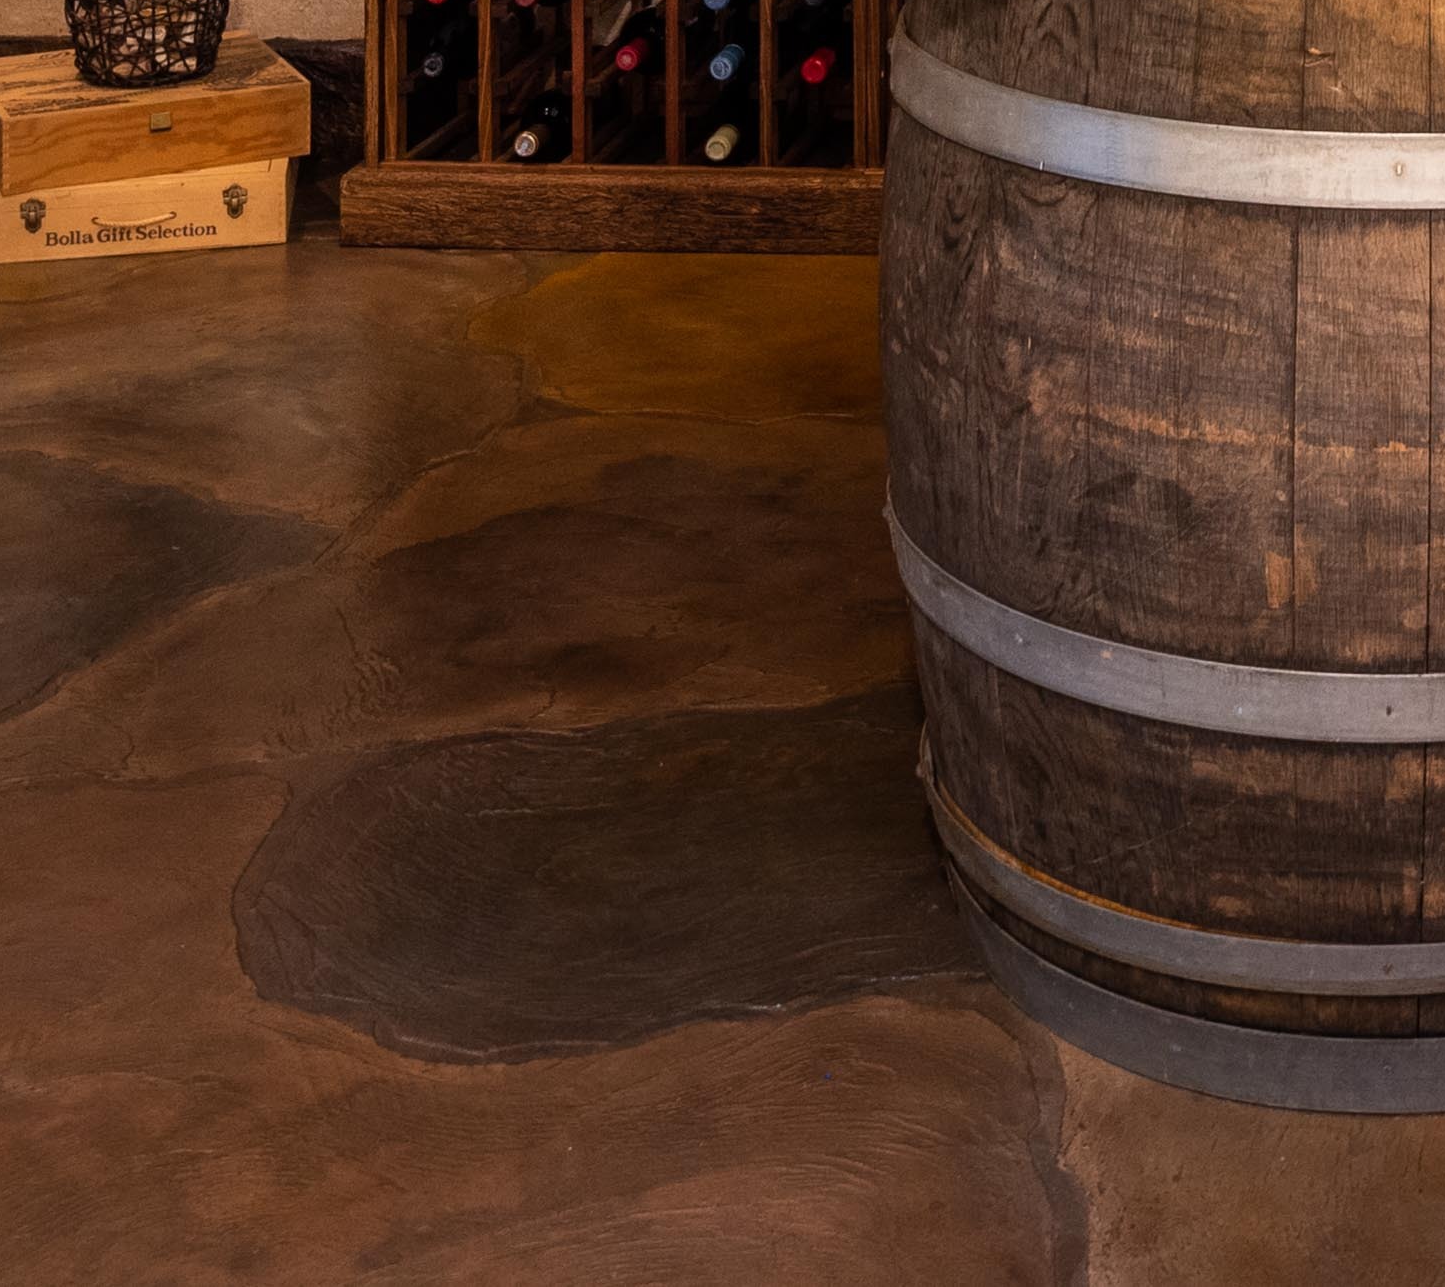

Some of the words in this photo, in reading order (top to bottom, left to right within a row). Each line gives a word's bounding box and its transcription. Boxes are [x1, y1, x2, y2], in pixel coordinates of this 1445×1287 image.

[44, 230, 94, 247] Bolla
[96, 226, 133, 244] Gift
[135, 223, 218, 241] Selection
